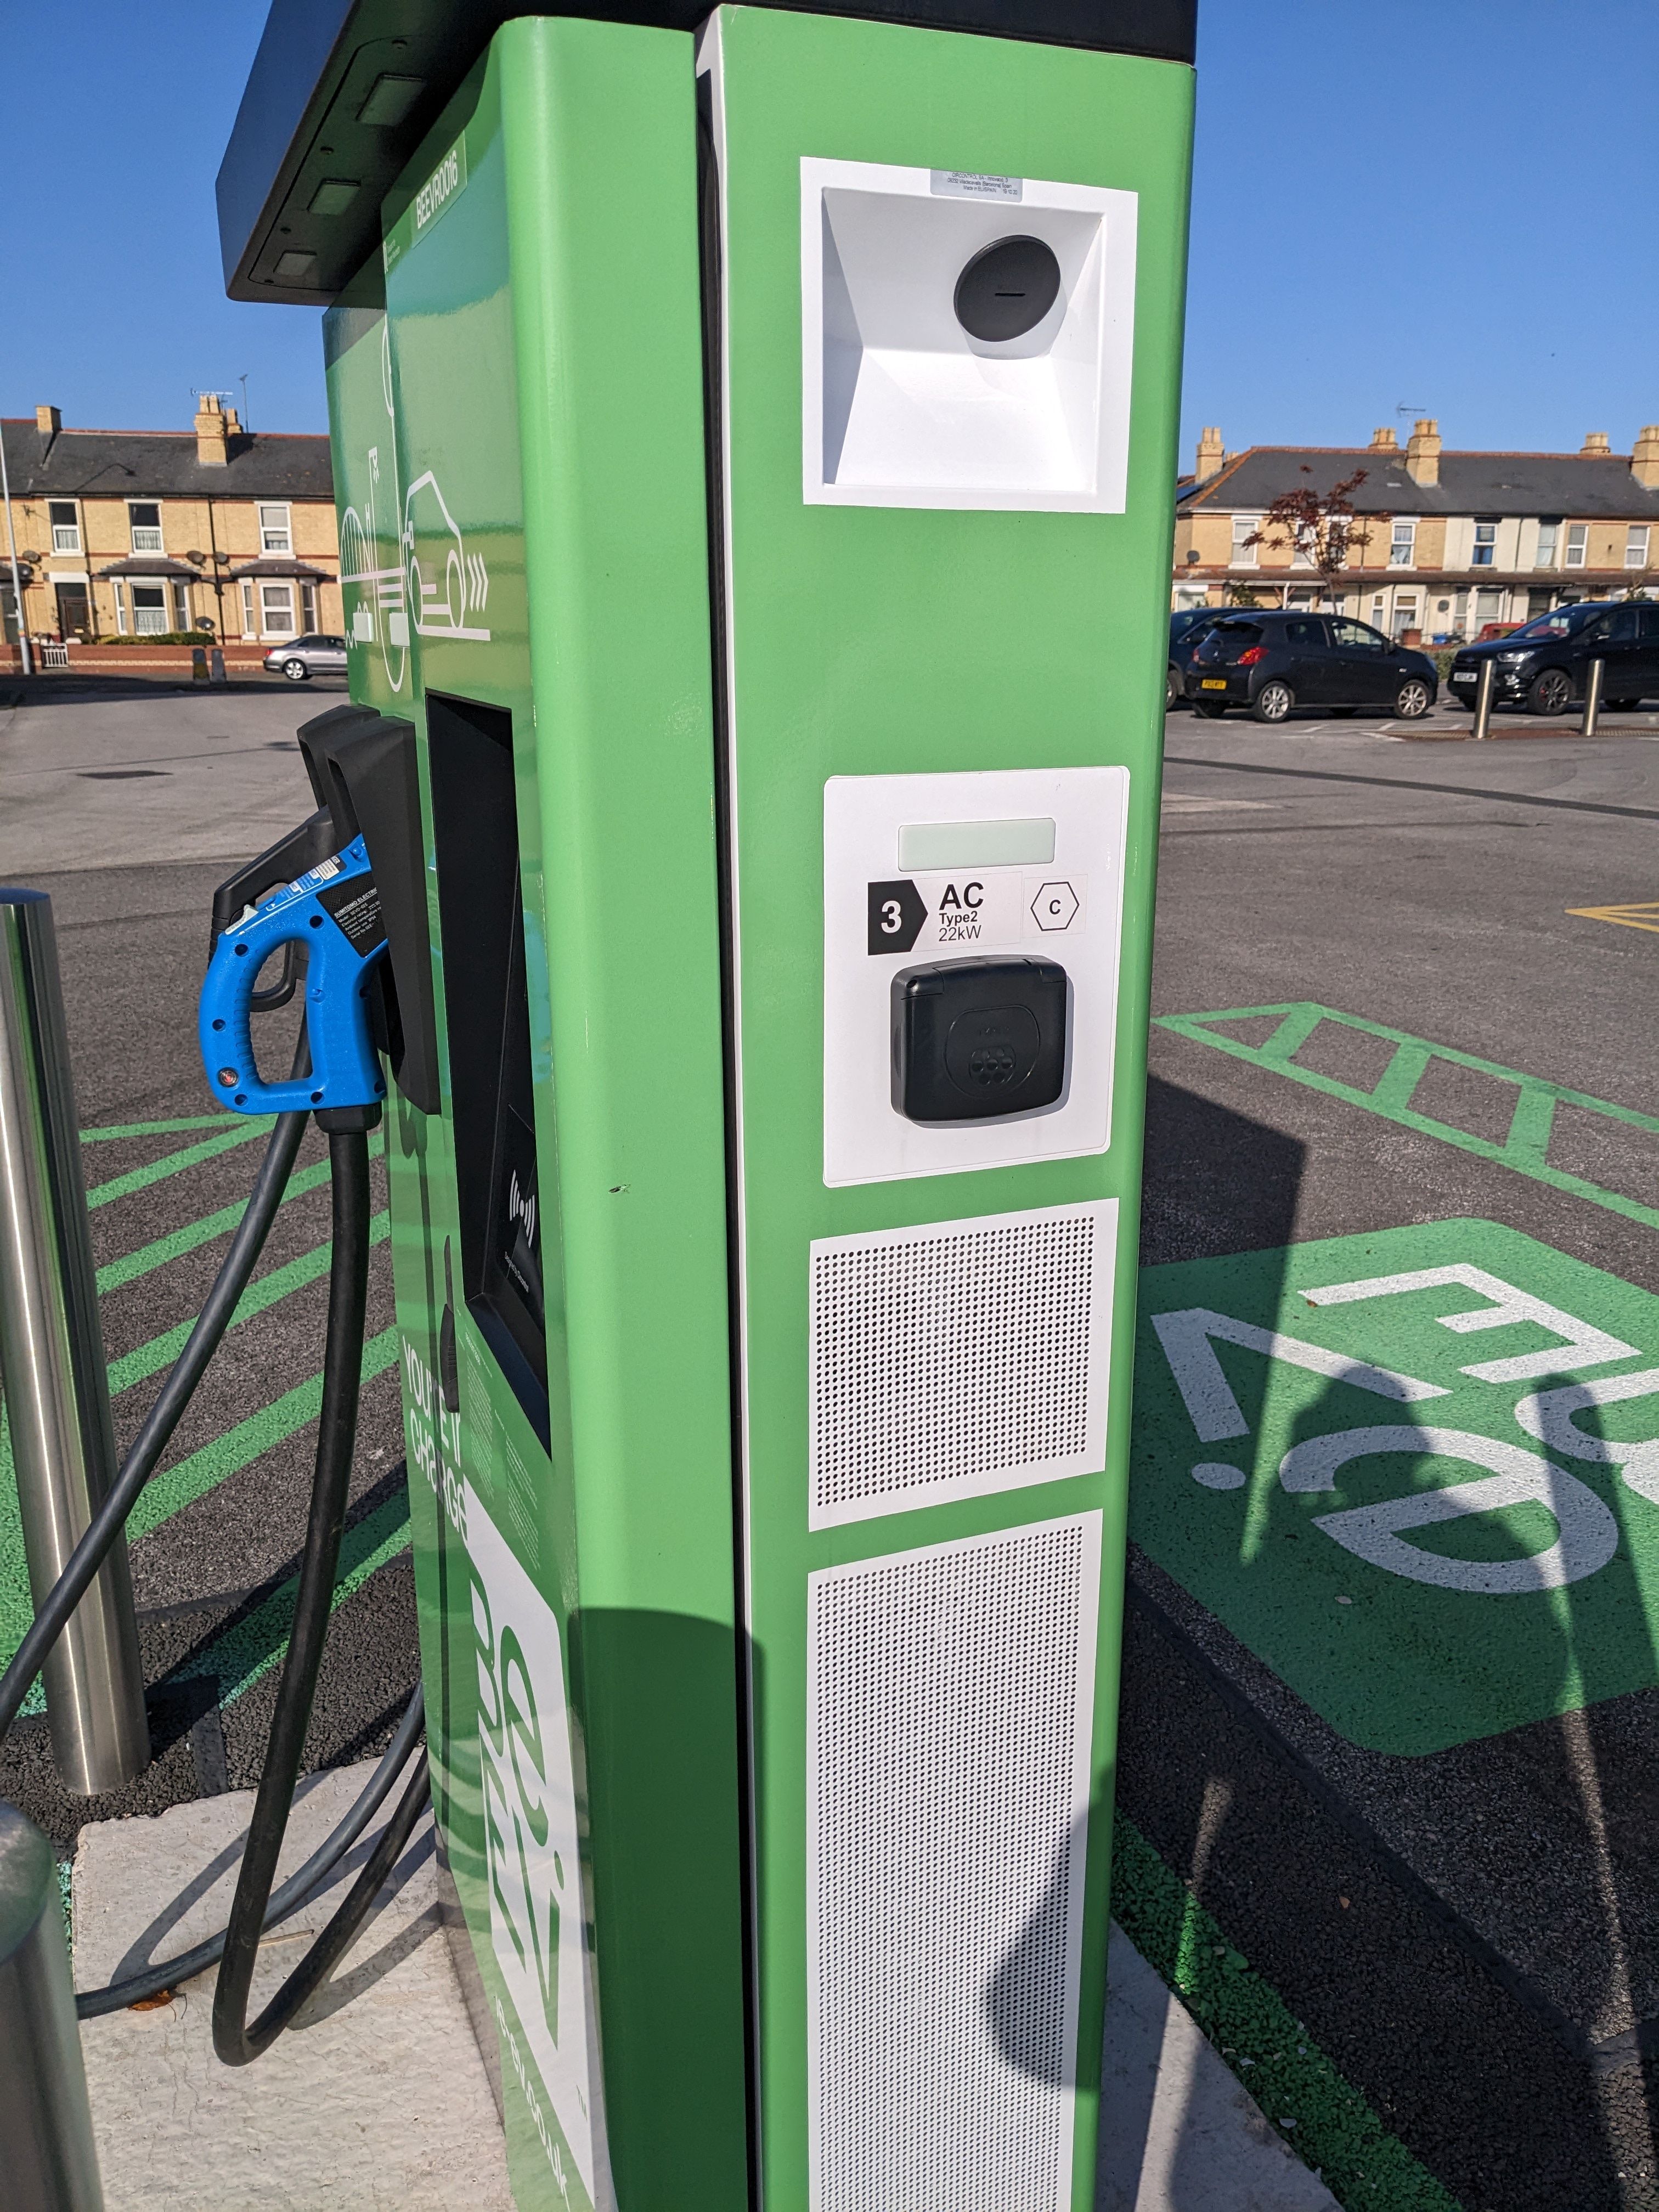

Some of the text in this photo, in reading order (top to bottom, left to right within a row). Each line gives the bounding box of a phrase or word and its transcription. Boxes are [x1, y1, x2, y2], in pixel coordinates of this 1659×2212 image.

[938, 882, 984, 911] AC
[334, 900, 358, 917] SUMITOMO
[1049, 899, 1061, 915] C
[881, 900, 901, 934] 3
[939, 911, 978, 927] Type2
[939, 925, 981, 942] 22kW
[496, 1993, 571, 2212] e-ev.co.uk
